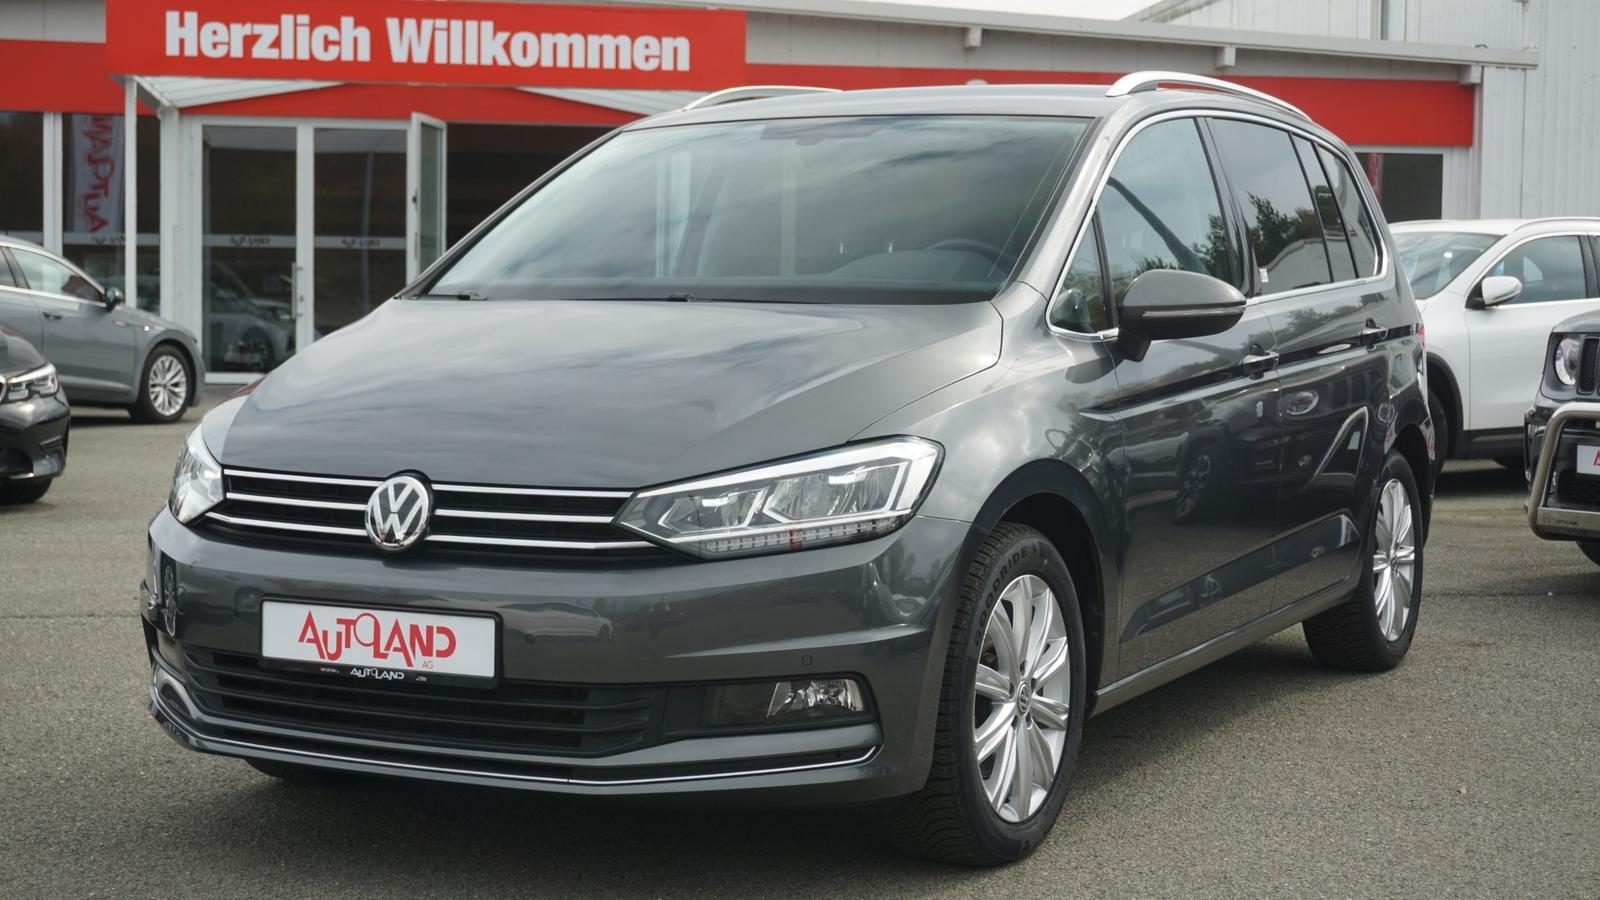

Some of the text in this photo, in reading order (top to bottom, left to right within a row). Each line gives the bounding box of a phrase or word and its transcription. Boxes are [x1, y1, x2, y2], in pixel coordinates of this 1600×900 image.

[165, 10, 691, 72] Herzlich Willkommen
[298, 609, 457, 668] AUTOLAND
[350, 667, 405, 681] AUTOLAND
[421, 660, 434, 670] AG
